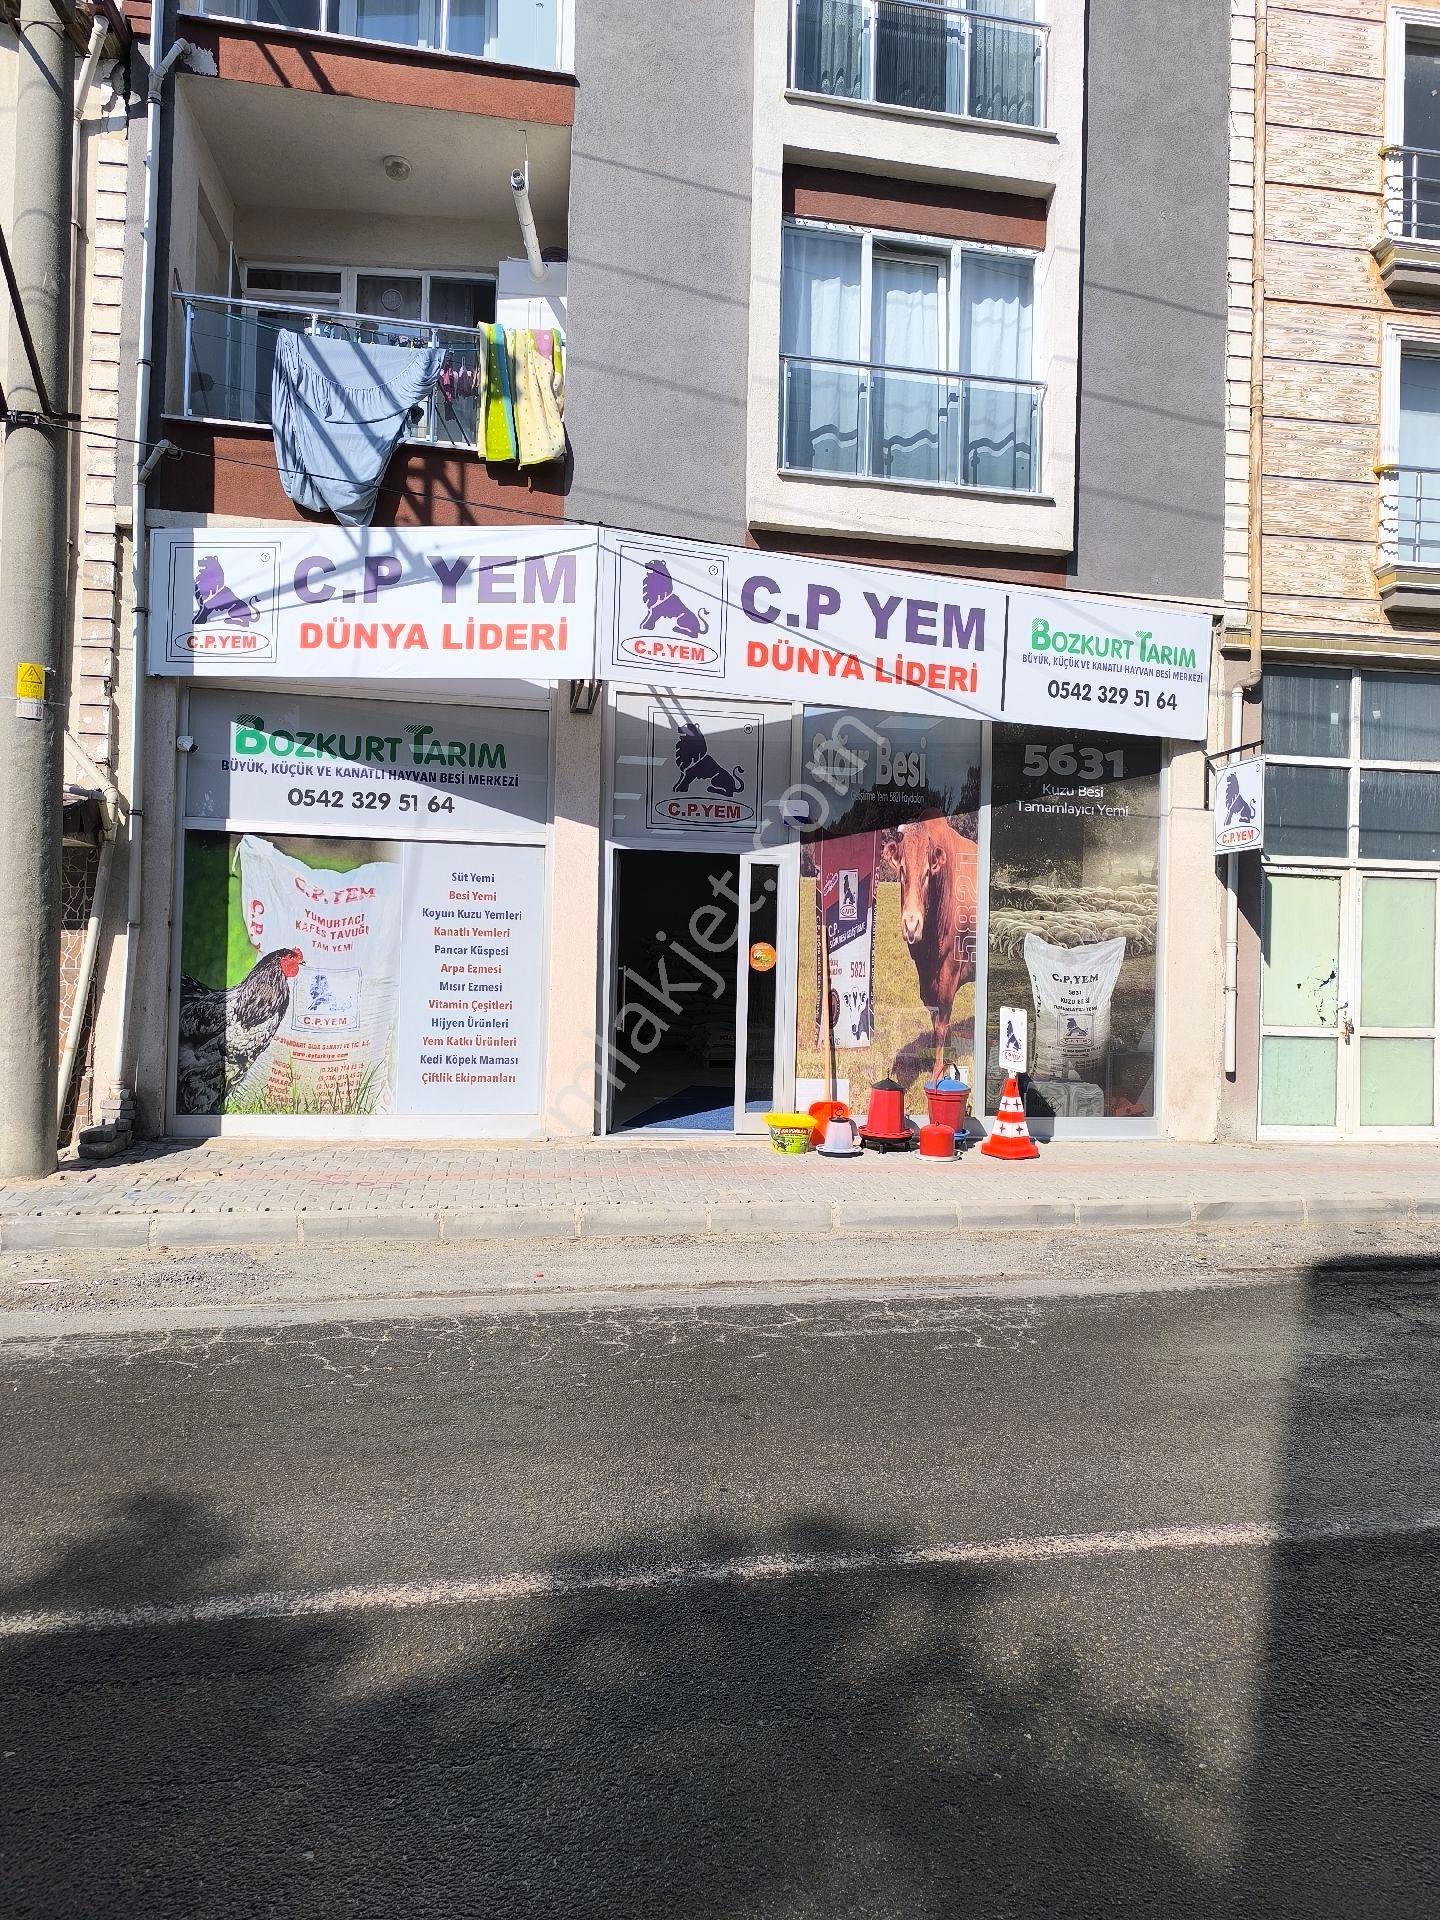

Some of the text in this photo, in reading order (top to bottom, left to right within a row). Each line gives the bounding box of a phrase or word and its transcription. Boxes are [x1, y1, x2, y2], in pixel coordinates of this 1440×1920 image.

[294, 555, 577, 604] C.P YEM
[740, 575, 986, 652] C.P YEM
[299, 616, 568, 650] DÜNYA LİDERİ
[186, 634, 257, 650] C.P.YEM
[1031, 617, 1197, 669] BOZKURT TARIM
[633, 640, 706, 663] C.P.YEM
[746, 638, 979, 694] DÜNYA LİDERİ
[1022, 654, 1204, 684] BÜYÜK, KÜÇÜK VE KANATLI HAYVAN BESİ MERKEZİ
[1047, 679, 1178, 710] 0542 329 51 64
[235, 713, 507, 769] BOZKURT TARIM
[876, 735, 929, 788] Besi
[1022, 743, 1124, 780] 5631
[221, 758, 519, 787] BÜYÜK, KÜÇÜK VE KANATLI HAYVAN BESİ MERKEZİ
[1042, 783, 1104, 799] Kuzu Besi
[287, 787, 455, 814] 0542 329 51 64
[1016, 800, 1129, 818] Tamamlayıcı Yemi
[667, 802, 741, 819] C.P.YEM
[1222, 829, 1254, 844] C.P.YEM
[451, 872, 495, 883] Süt Yemi
[449, 890, 497, 901] Besi Yemi
[422, 908, 522, 920] Koyun Kuzu Yemleri
[953, 852, 979, 963] 5821
[304, 908, 365, 928] YUMURTACI
[295, 920, 327, 938] KAFES
[434, 926, 510, 937] Kanatlı Yemleri
[312, 940, 329, 952] TAM
[434, 944, 509, 958] Pancar Küspesi
[440, 963, 502, 975] Arpa Ezmesi
[850, 961, 866, 978] 5821
[439, 981, 503, 992] Mısır Ezmesi
[1052, 973, 1099, 984] C.P.YEM
[428, 999, 513, 1012] Vitamin Çeşitleri
[303, 1016, 347, 1026] C.P.YEM
[431, 1016, 509, 1030] Hijyen Ürünleri
[422, 1034, 517, 1047] Yem Katkı Ürünleri
[420, 1054, 519, 1067] Kedi Köpek Maması
[421, 1072, 516, 1085] Çiftlik Ekipmanları
